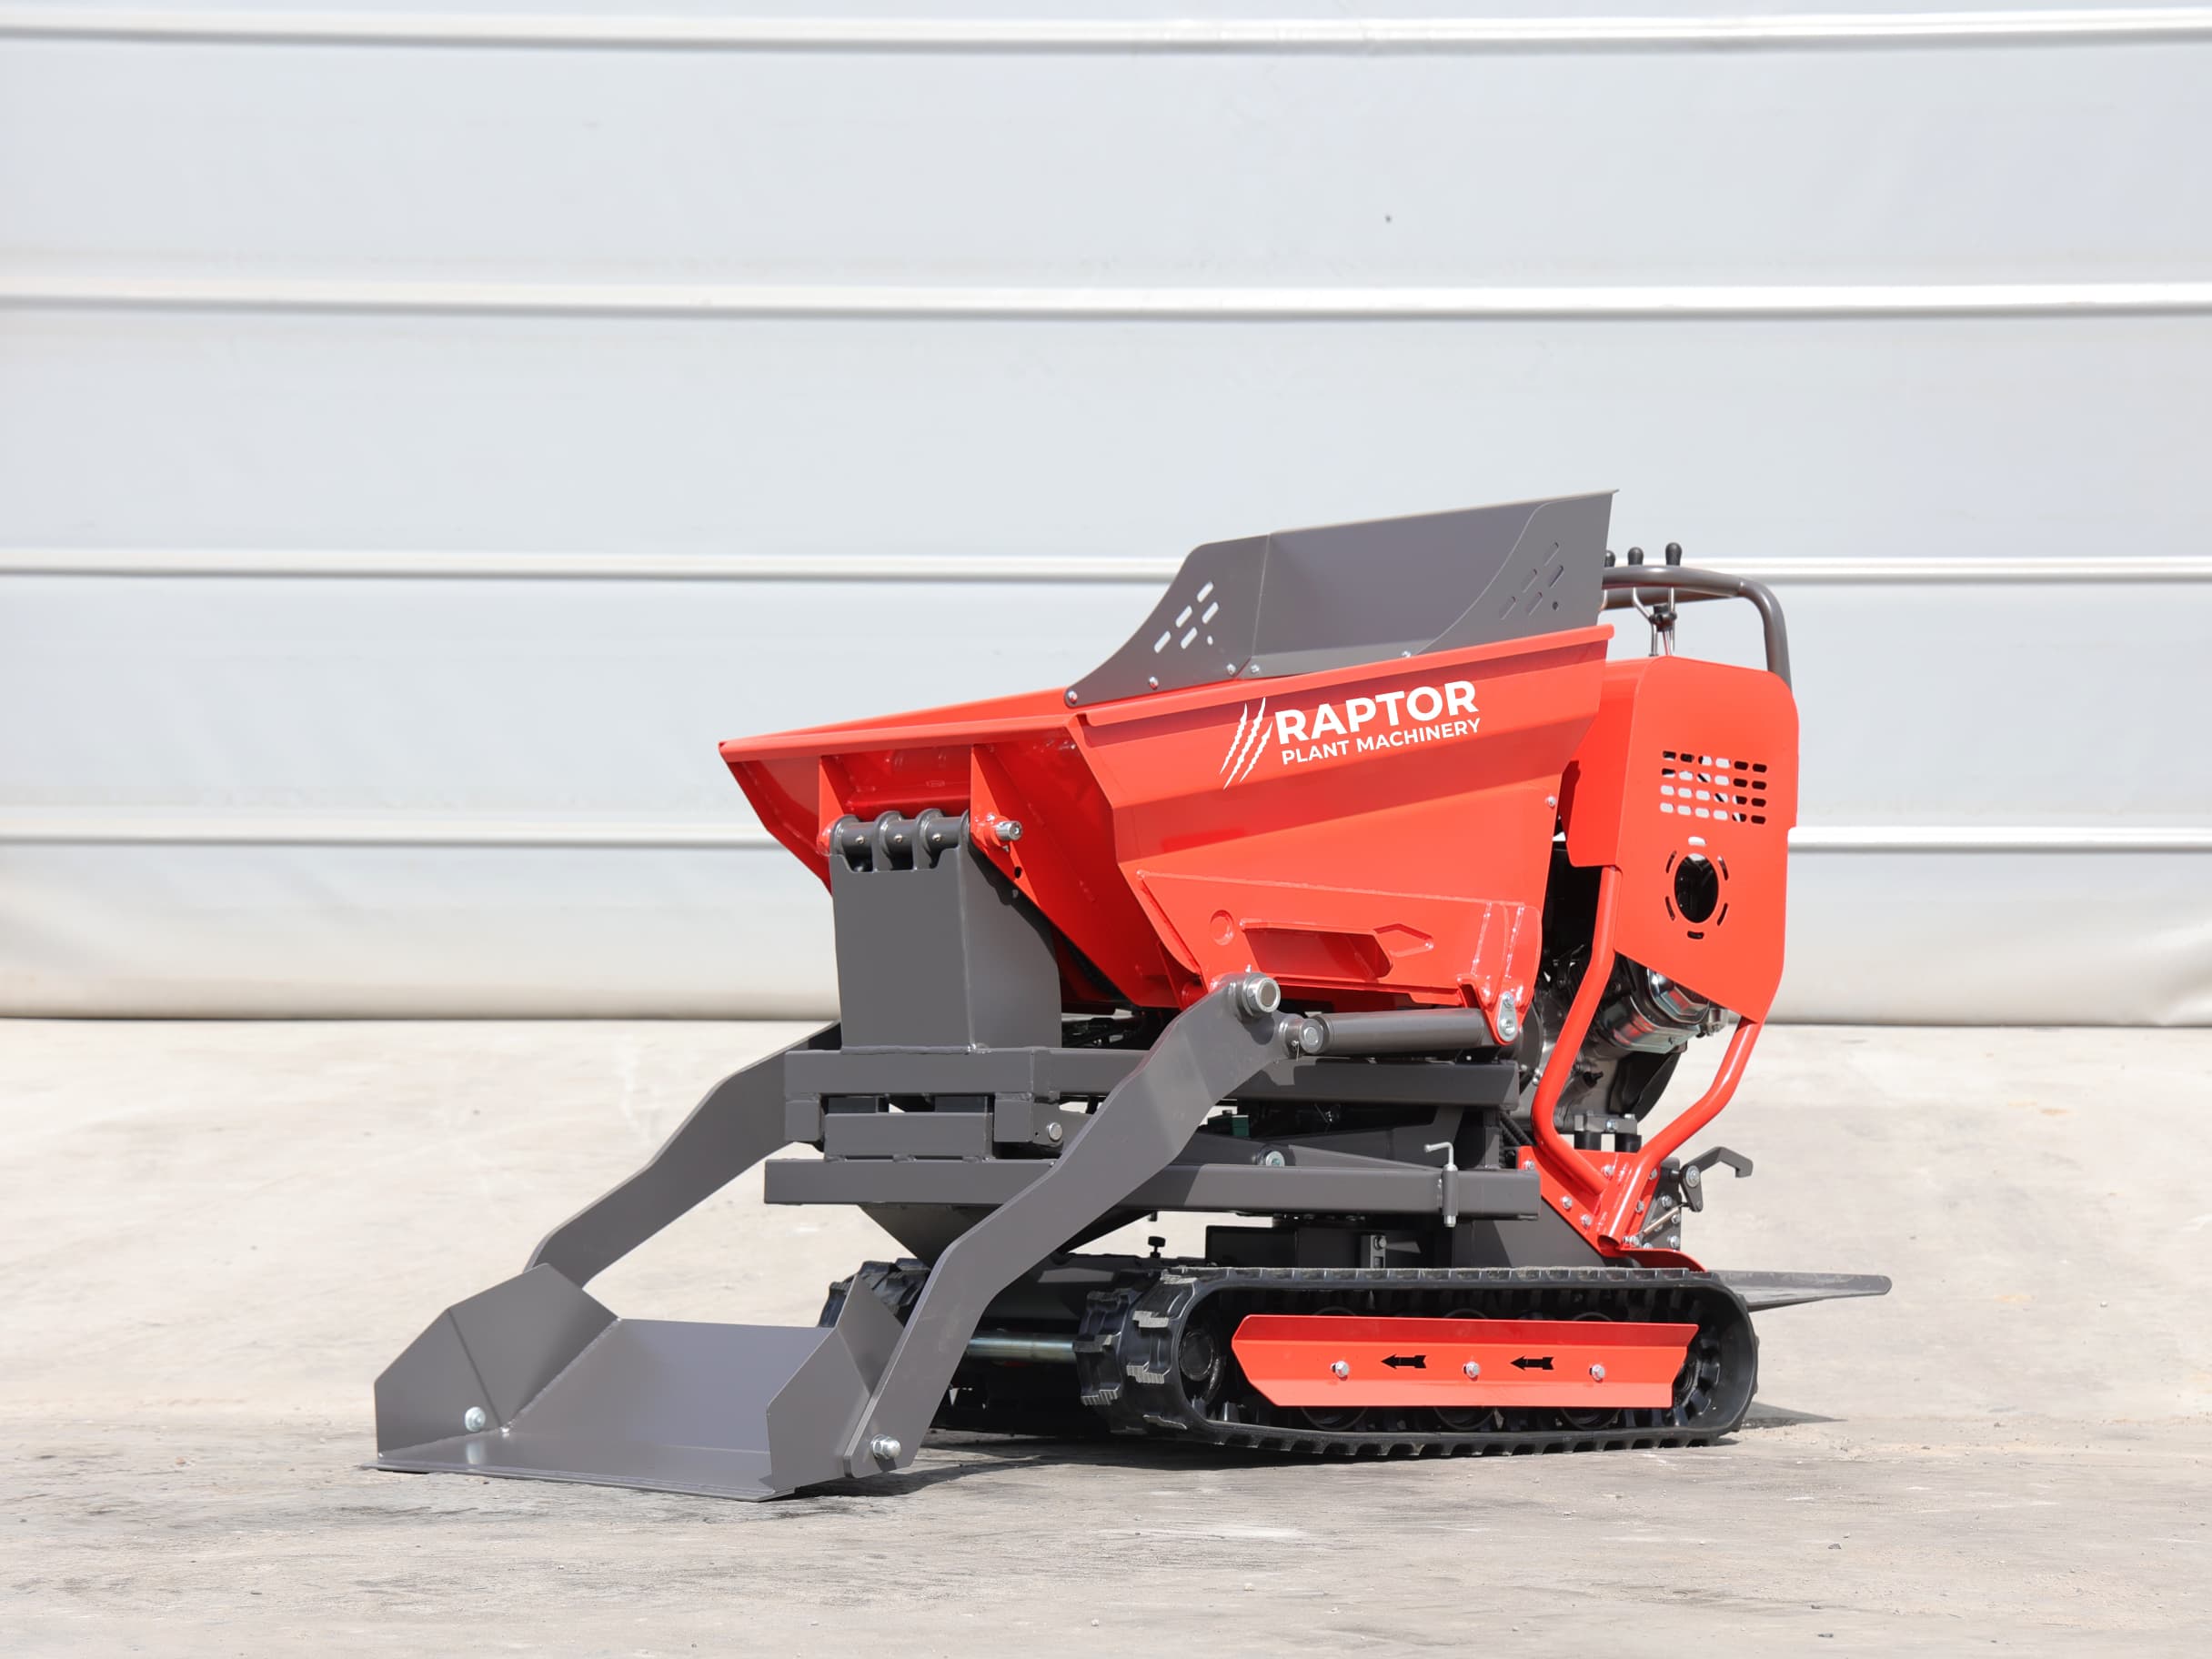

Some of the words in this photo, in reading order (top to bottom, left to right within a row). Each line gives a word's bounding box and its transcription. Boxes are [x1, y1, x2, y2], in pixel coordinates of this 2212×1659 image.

[1274, 680, 1479, 745] RAPTOR
[1282, 739, 1349, 765] PLANT
[1356, 718, 1481, 753] MACHINERY
